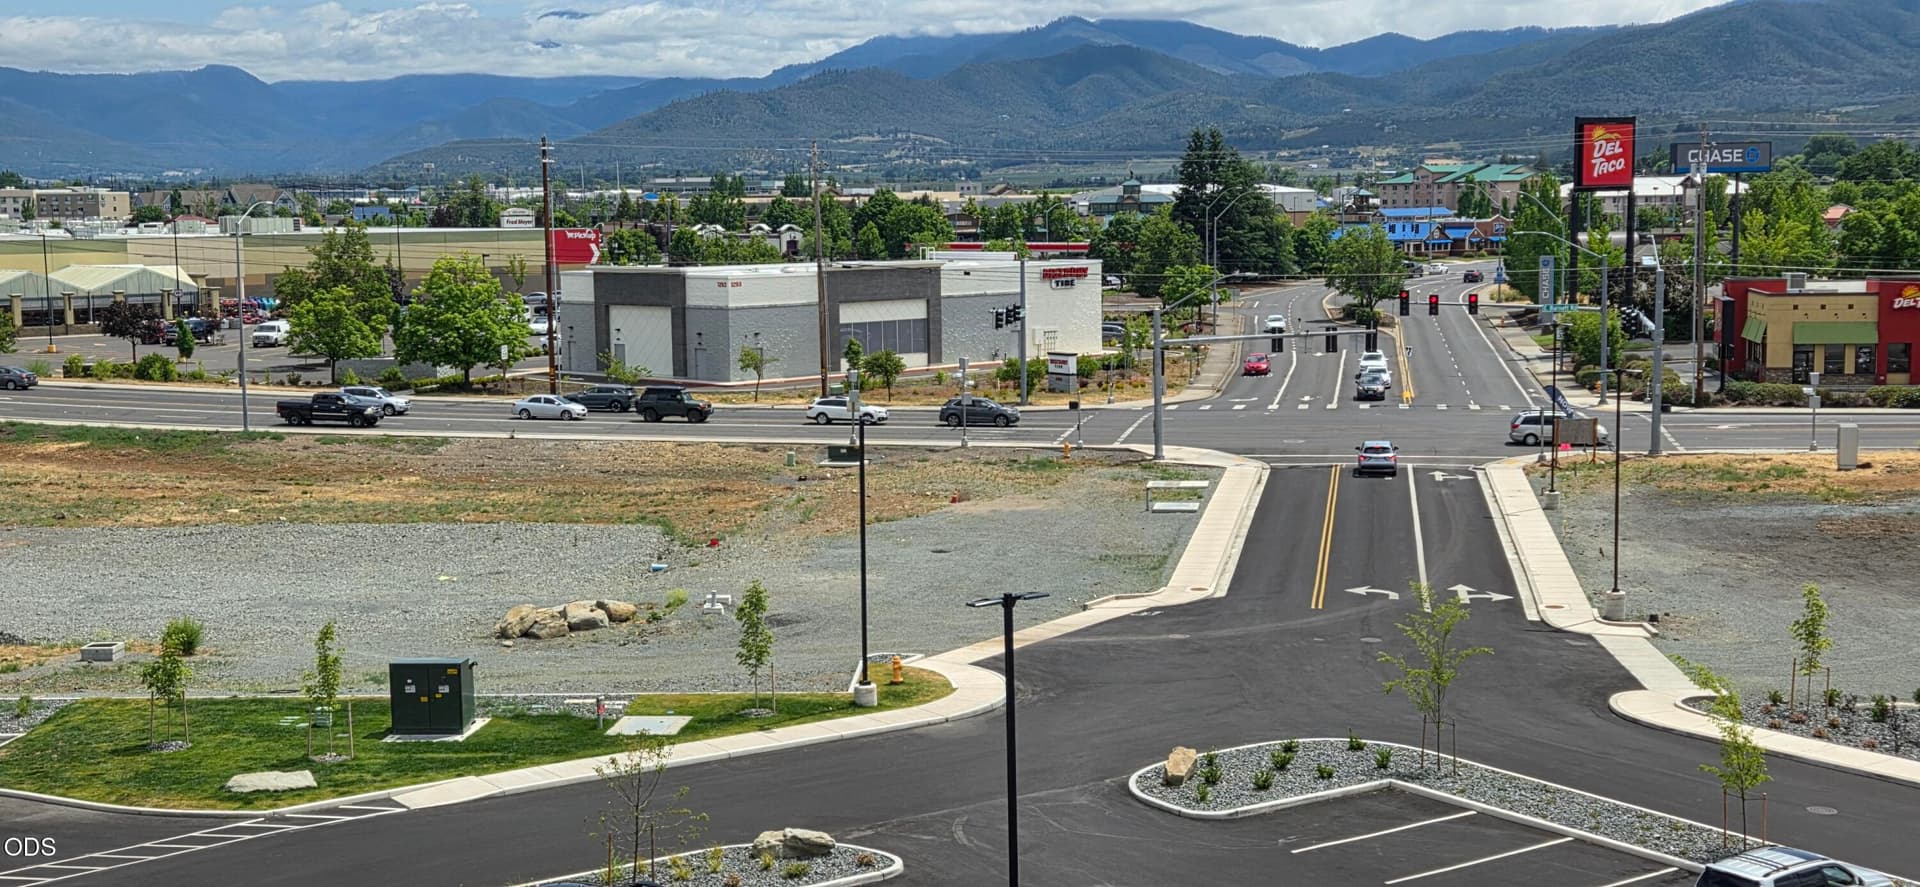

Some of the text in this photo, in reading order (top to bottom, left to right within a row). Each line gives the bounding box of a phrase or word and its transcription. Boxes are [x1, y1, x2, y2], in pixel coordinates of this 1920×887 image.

[1593, 140, 1623, 158] DEL
[1688, 149, 1743, 163] CHASE
[1591, 157, 1625, 178] TACO
[1542, 268, 1550, 299] CHASE
[1893, 298, 1917, 309] DEL
